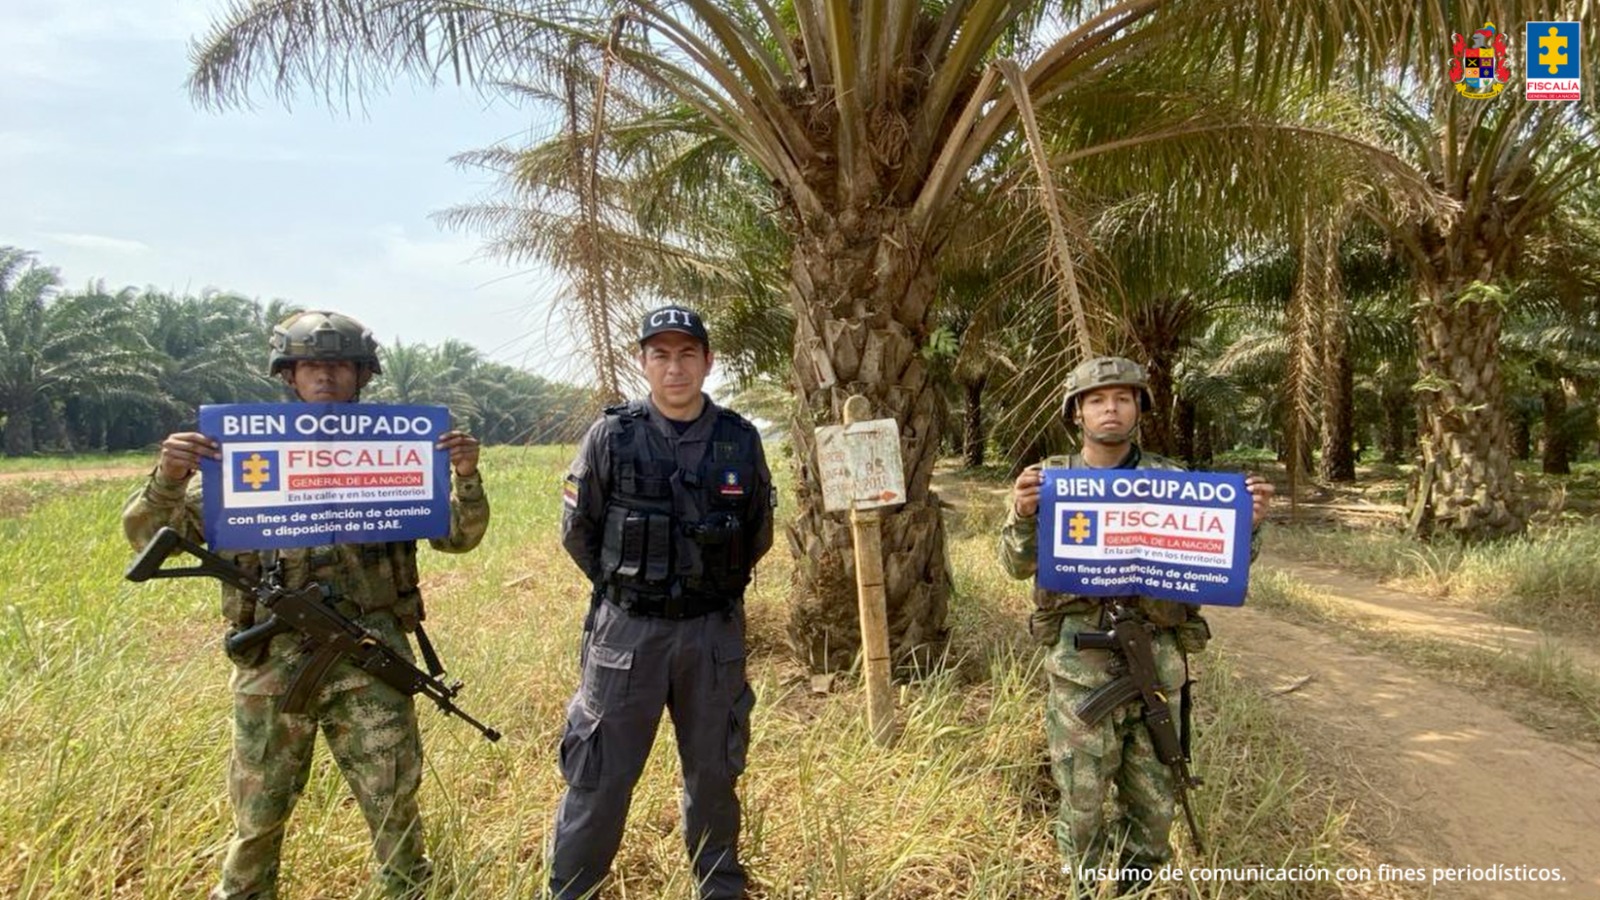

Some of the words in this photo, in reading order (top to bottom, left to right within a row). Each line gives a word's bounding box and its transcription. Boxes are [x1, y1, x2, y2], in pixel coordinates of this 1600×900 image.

[650, 309, 692, 327] CTI
[223, 415, 285, 435] BIEN
[295, 414, 432, 435] OCUPADO
[288, 445, 422, 468] FISCALÍA
[292, 478, 344, 488] GENERAL
[346, 477, 361, 486] DE
[363, 476, 377, 486] LA
[377, 474, 421, 485] NACIÓN
[1056, 478, 1105, 497] BIEN
[1112, 478, 1236, 503] OCUPADO
[288, 494, 301, 502] En
[302, 492, 313, 502] la
[313, 491, 336, 501] calle
[338, 492, 344, 501] y
[346, 491, 359, 499] en
[361, 489, 375, 498] los
[377, 487, 426, 497] territorios
[227, 515, 254, 525] con
[256, 513, 287, 524] fines
[290, 512, 307, 522] de
[310, 508, 363, 521] extinción
[366, 507, 382, 518] de
[385, 506, 432, 517] dominio
[1104, 511, 1225, 533] FISCALÍA
[262, 528, 272, 537] a
[275, 521, 342, 537] disposición
[344, 521, 360, 531] de
[363, 520, 374, 530] la
[377, 519, 402, 530] SAE.
[1106, 535, 1146, 545] GENERAL
[1150, 538, 1165, 547] DE
[1167, 539, 1181, 548] LA
[1181, 538, 1222, 551] NACIÓN
[1104, 547, 1116, 555] En
[1144, 549, 1150, 557] y
[1165, 550, 1179, 560] los
[1180, 552, 1227, 565] territorios
[1055, 564, 1076, 573] con
[1078, 565, 1102, 574] fines
[1104, 565, 1117, 574] de
[1119, 565, 1163, 577] extinción
[1166, 568, 1181, 579] de
[1183, 571, 1229, 584] dominio
[1081, 577, 1089, 585] a
[1091, 574, 1143, 587] disposición
[1145, 577, 1160, 588] de
[1162, 578, 1173, 588] la
[1174, 582, 1199, 593] SAE.
